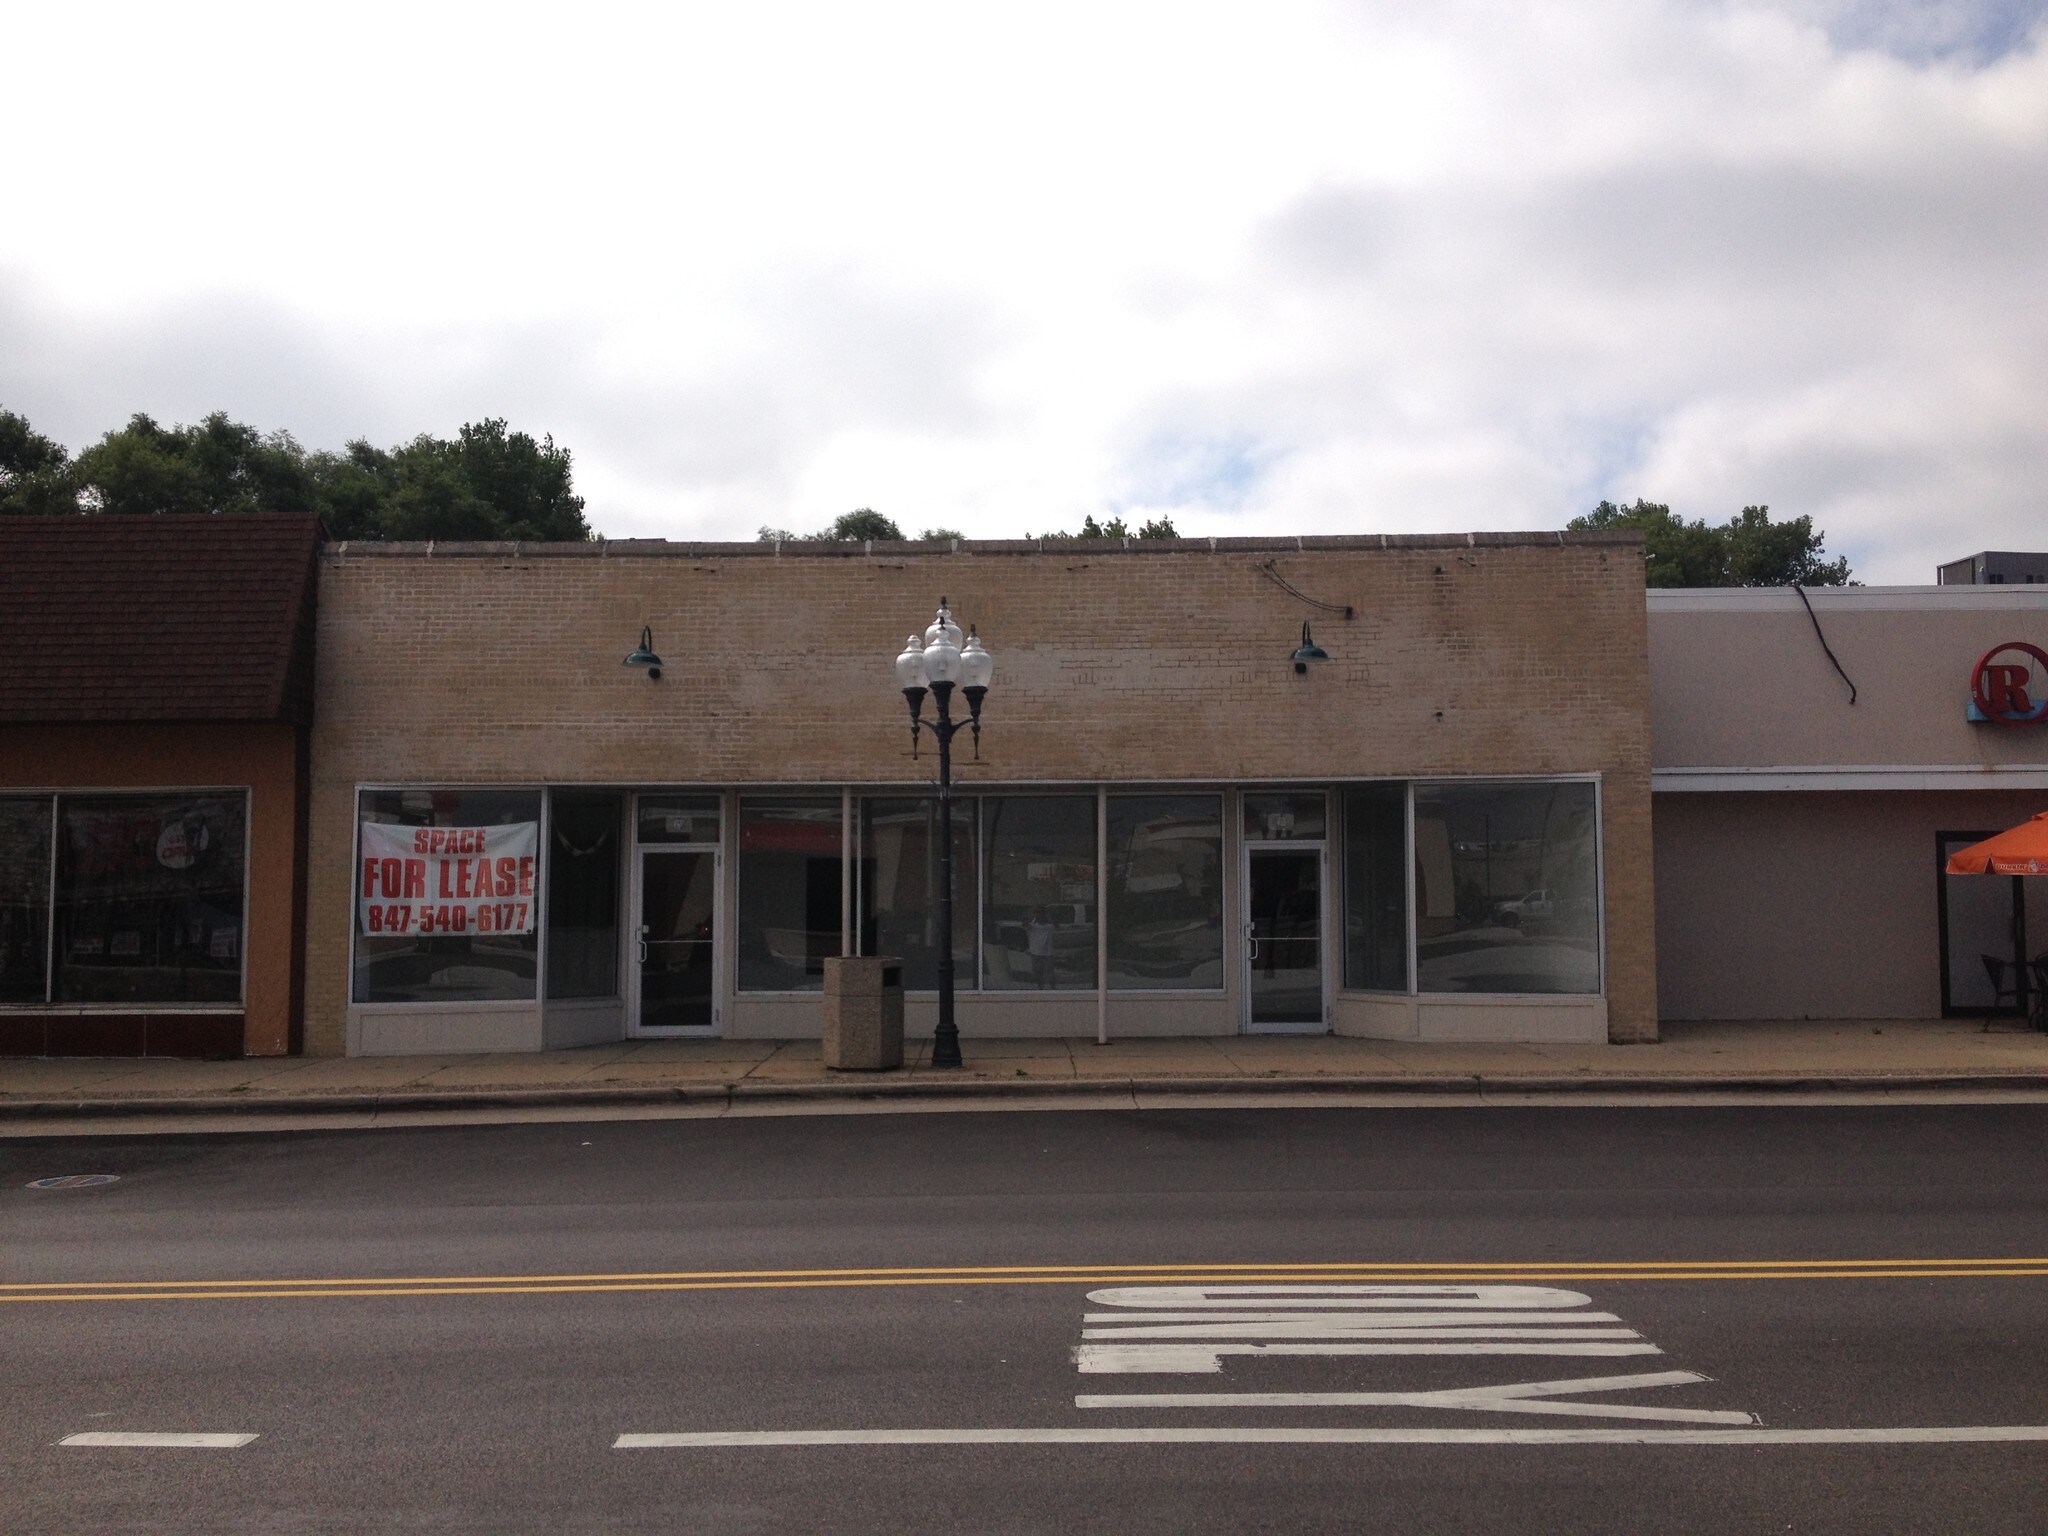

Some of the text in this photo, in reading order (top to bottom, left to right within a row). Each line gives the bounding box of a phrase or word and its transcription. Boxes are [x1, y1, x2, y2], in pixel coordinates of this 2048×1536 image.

[414, 829, 486, 854] SPACE
[363, 856, 534, 899] FOR LEASE
[369, 903, 528, 933] 847-540-6177
